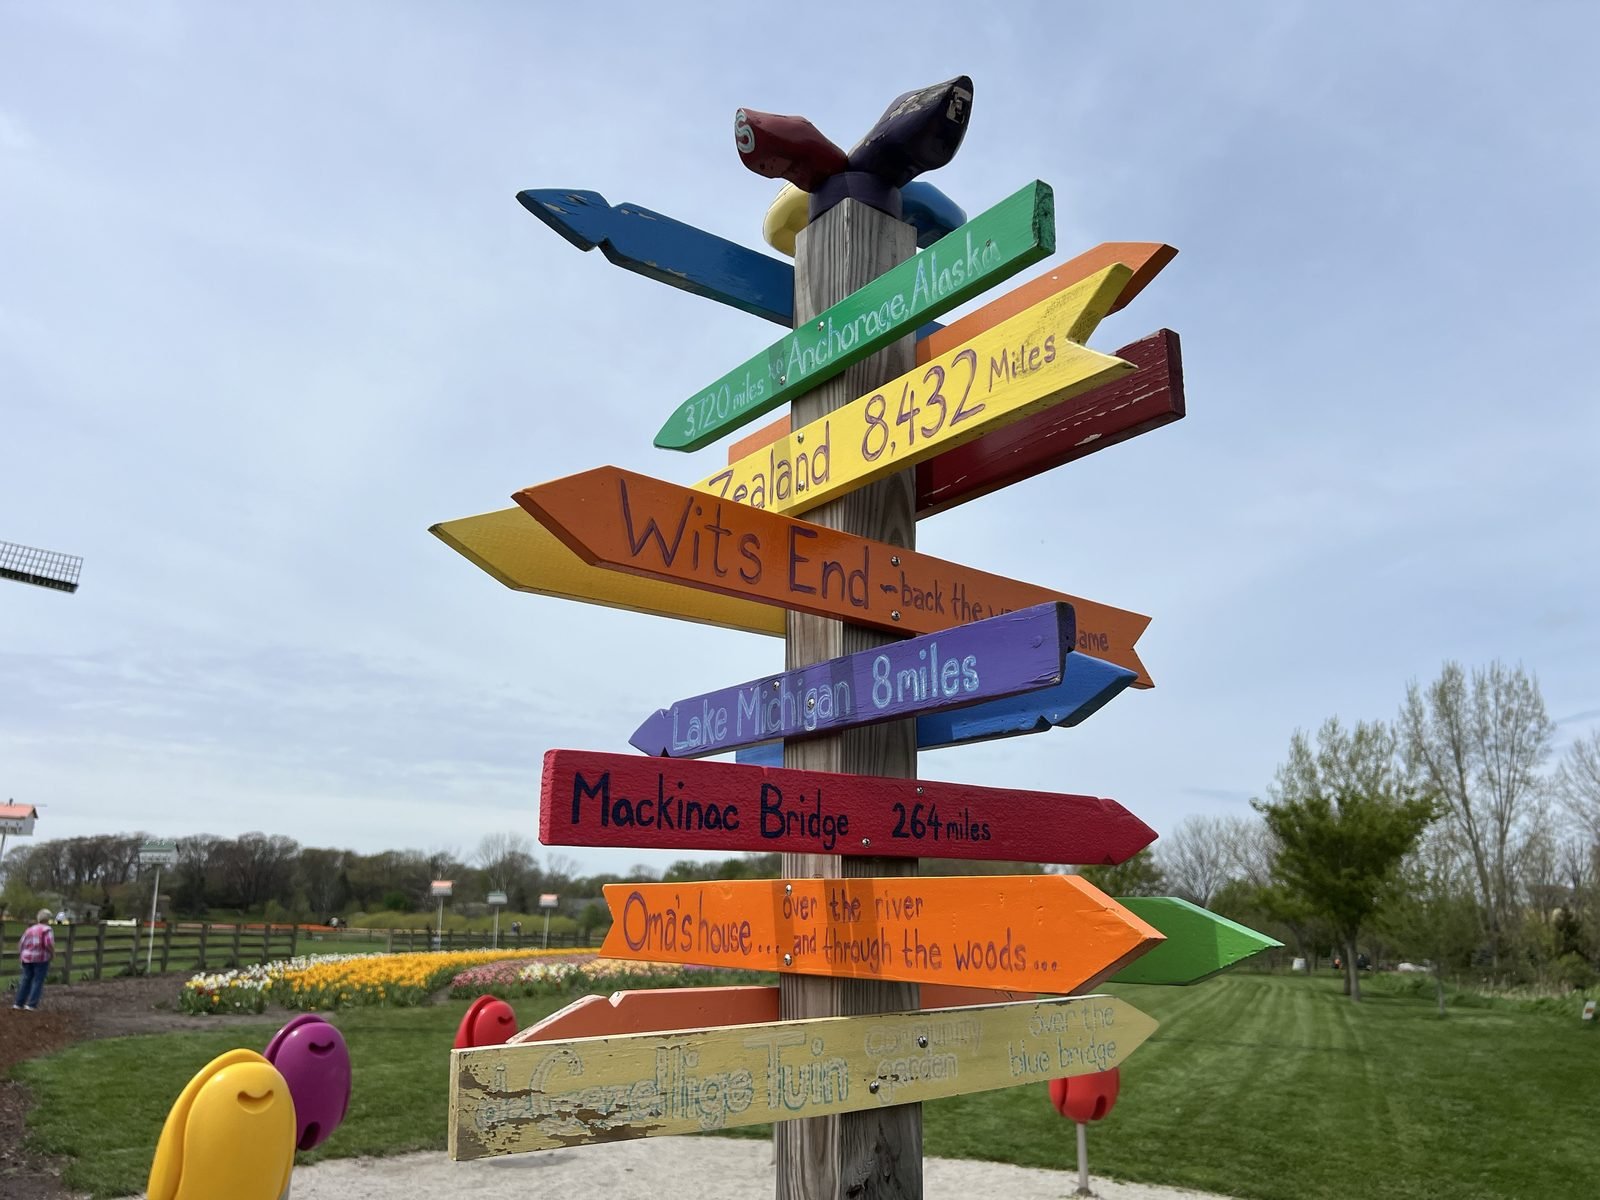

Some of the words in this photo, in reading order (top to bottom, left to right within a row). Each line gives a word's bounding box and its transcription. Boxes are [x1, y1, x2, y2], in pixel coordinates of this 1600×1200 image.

[735, 111, 756, 154] S
[733, 370, 764, 411] miles
[786, 291, 909, 383] Anchorage,
[910, 230, 1001, 315] Alaska
[861, 348, 986, 463] 8,432
[989, 334, 1057, 393] Miles
[620, 478, 762, 585] Wits
[788, 524, 870, 610] End
[951, 582, 983, 622] the
[1077, 630, 1109, 652] ame
[672, 700, 728, 751] Lake
[736, 680, 851, 737] Michigan
[571, 771, 740, 831] Mackinac
[760, 783, 849, 850] Bridge
[892, 802, 943, 841] 264
[945, 807, 992, 842] miles
[623, 891, 693, 953] Oma's
[782, 895, 818, 920] over
[829, 888, 861, 922] the
[875, 890, 924, 920] river
[793, 928, 817, 956] and
[822, 926, 892, 973] through
[902, 928, 942, 969] the
[1081, 1002, 1114, 1031] the
[742, 1030, 849, 1112] Tuin
[1008, 1038, 1050, 1077] blue
[1056, 1034, 1117, 1073] bridge
